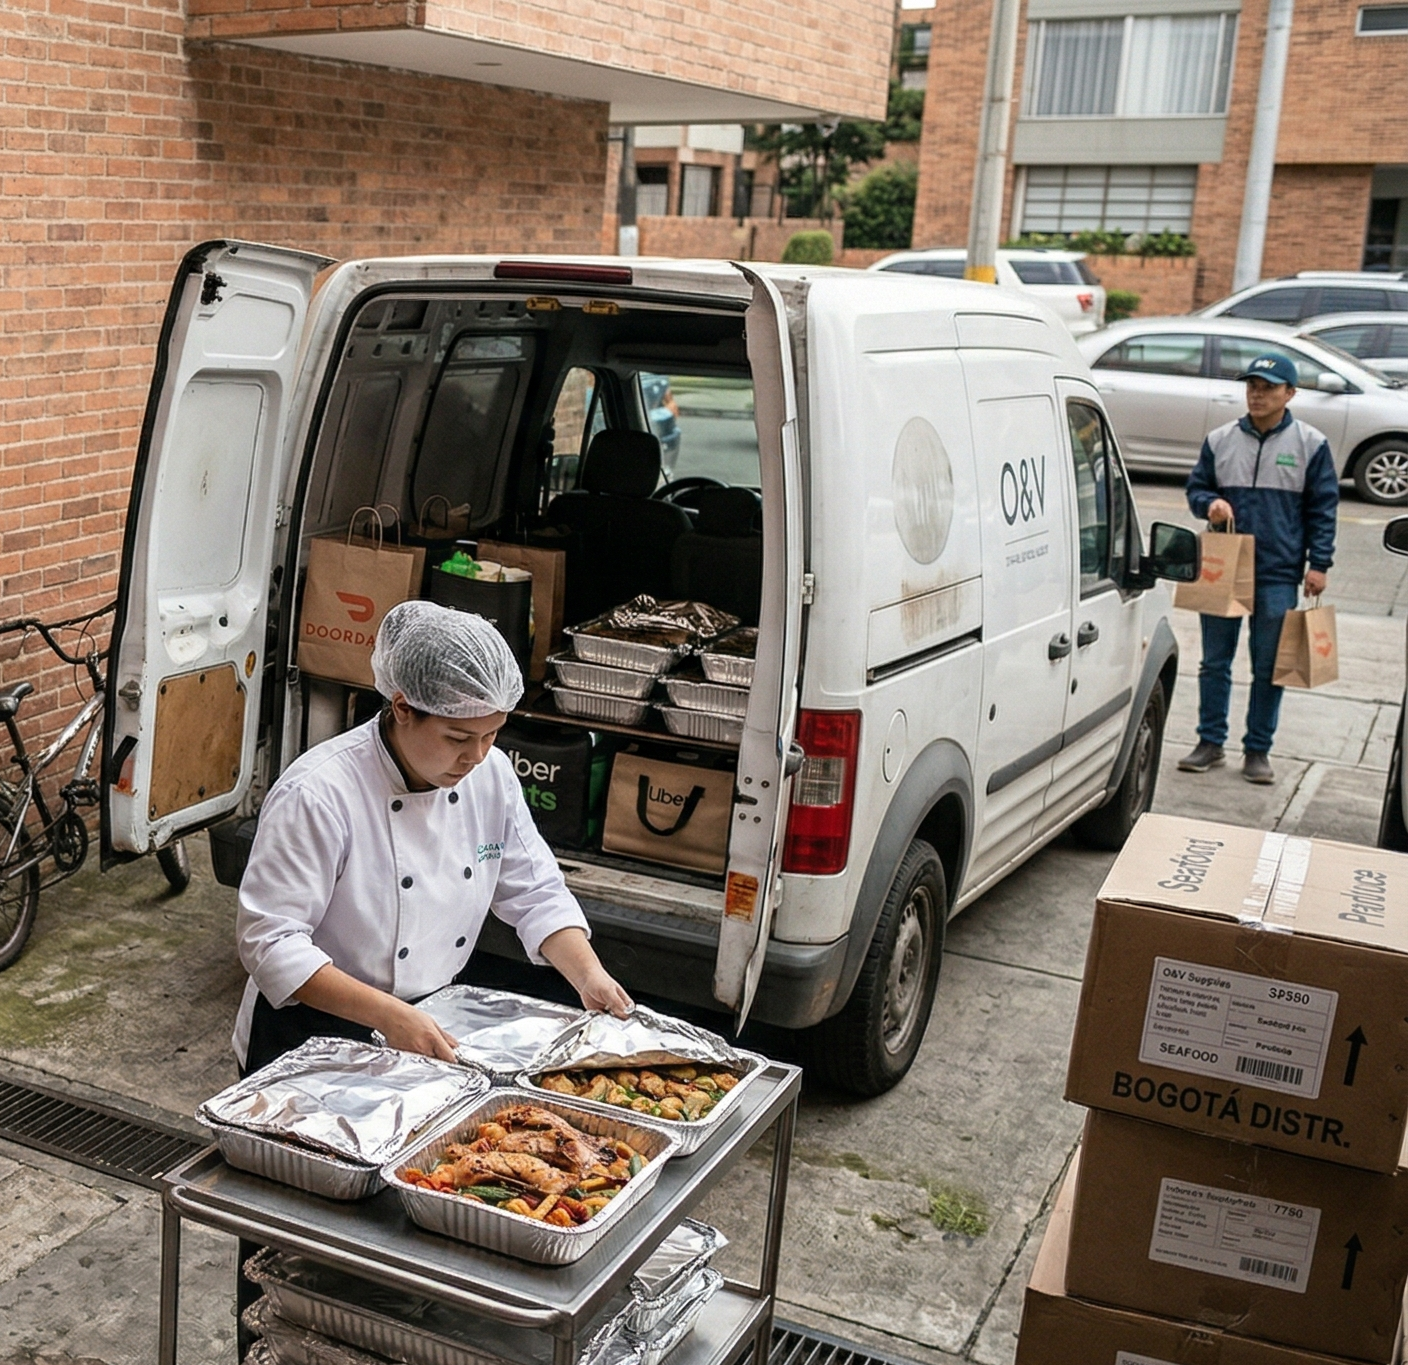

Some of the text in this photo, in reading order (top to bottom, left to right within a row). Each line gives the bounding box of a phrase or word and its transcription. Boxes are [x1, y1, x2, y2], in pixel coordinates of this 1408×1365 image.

[1001, 455, 1045, 526] O&V
[306, 623, 376, 648] DOORDA
[1159, 1042, 1218, 1064] SEAFOOD
[1112, 1071, 1351, 1148] BOGOTÁ DISTR.
